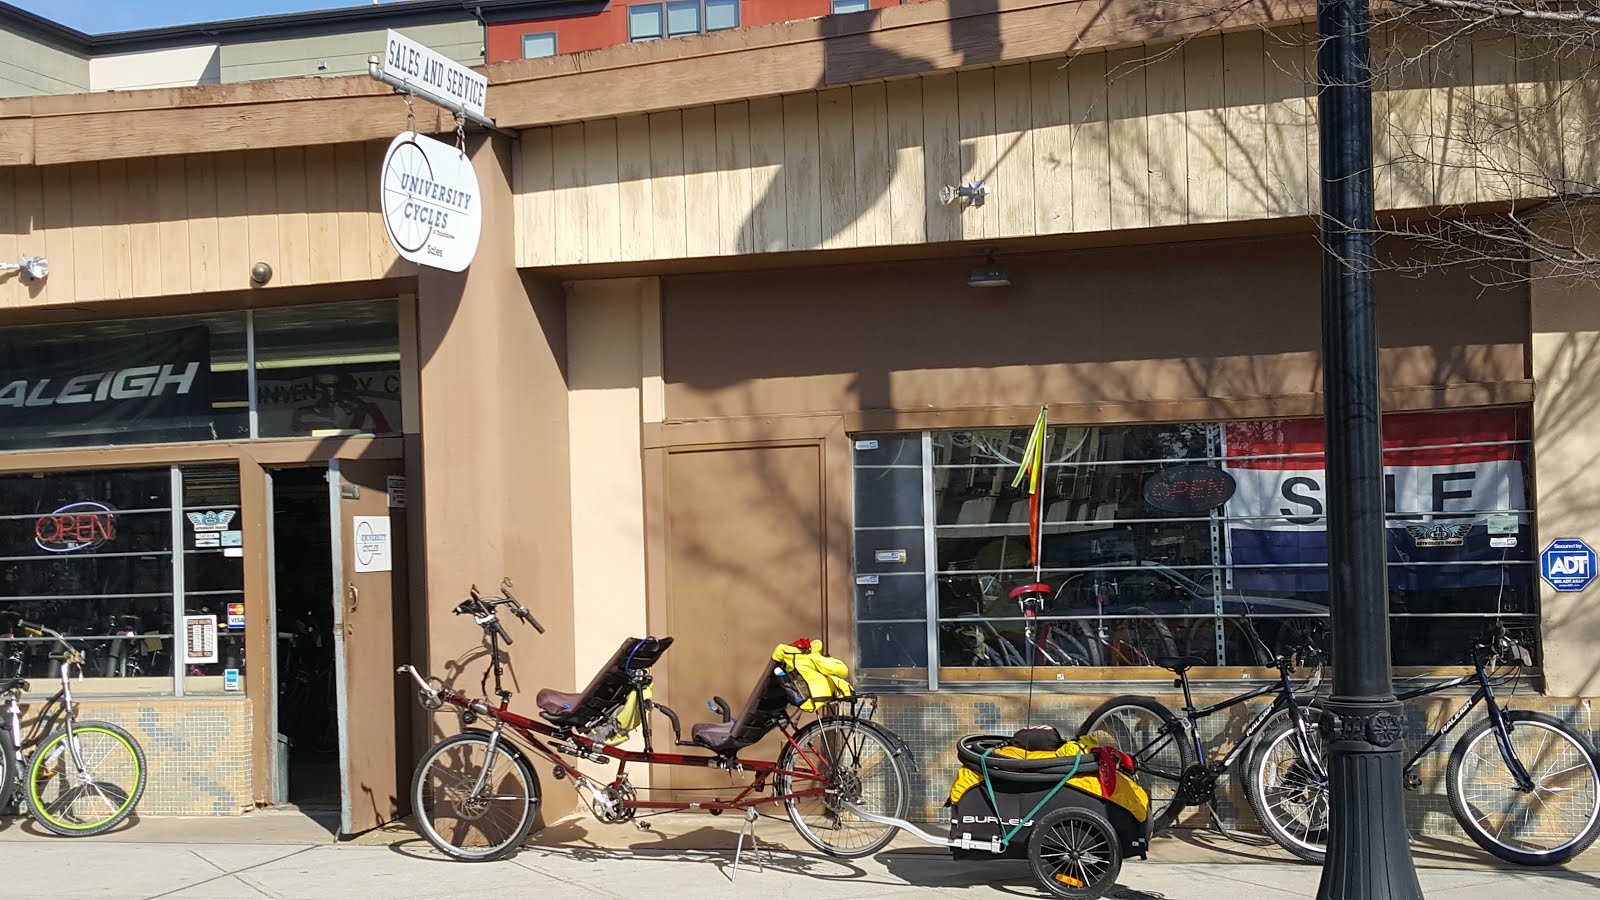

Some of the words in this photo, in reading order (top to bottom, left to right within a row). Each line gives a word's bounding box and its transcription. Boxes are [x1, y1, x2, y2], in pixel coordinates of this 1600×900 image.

[388, 40, 421, 78] SALES
[422, 57, 444, 88] AND
[446, 68, 484, 107] SERVICE
[401, 173, 471, 209] UNIVERSITY
[404, 202, 448, 229] CYCLES
[1152, 478, 1225, 501] OPEN
[1280, 471, 1476, 525] SLE
[34, 514, 112, 542] OPEN
[1550, 556, 1588, 574] ADT
[1246, 703, 1275, 737] RALEIGH
[1440, 699, 1473, 735] RALEIGH
